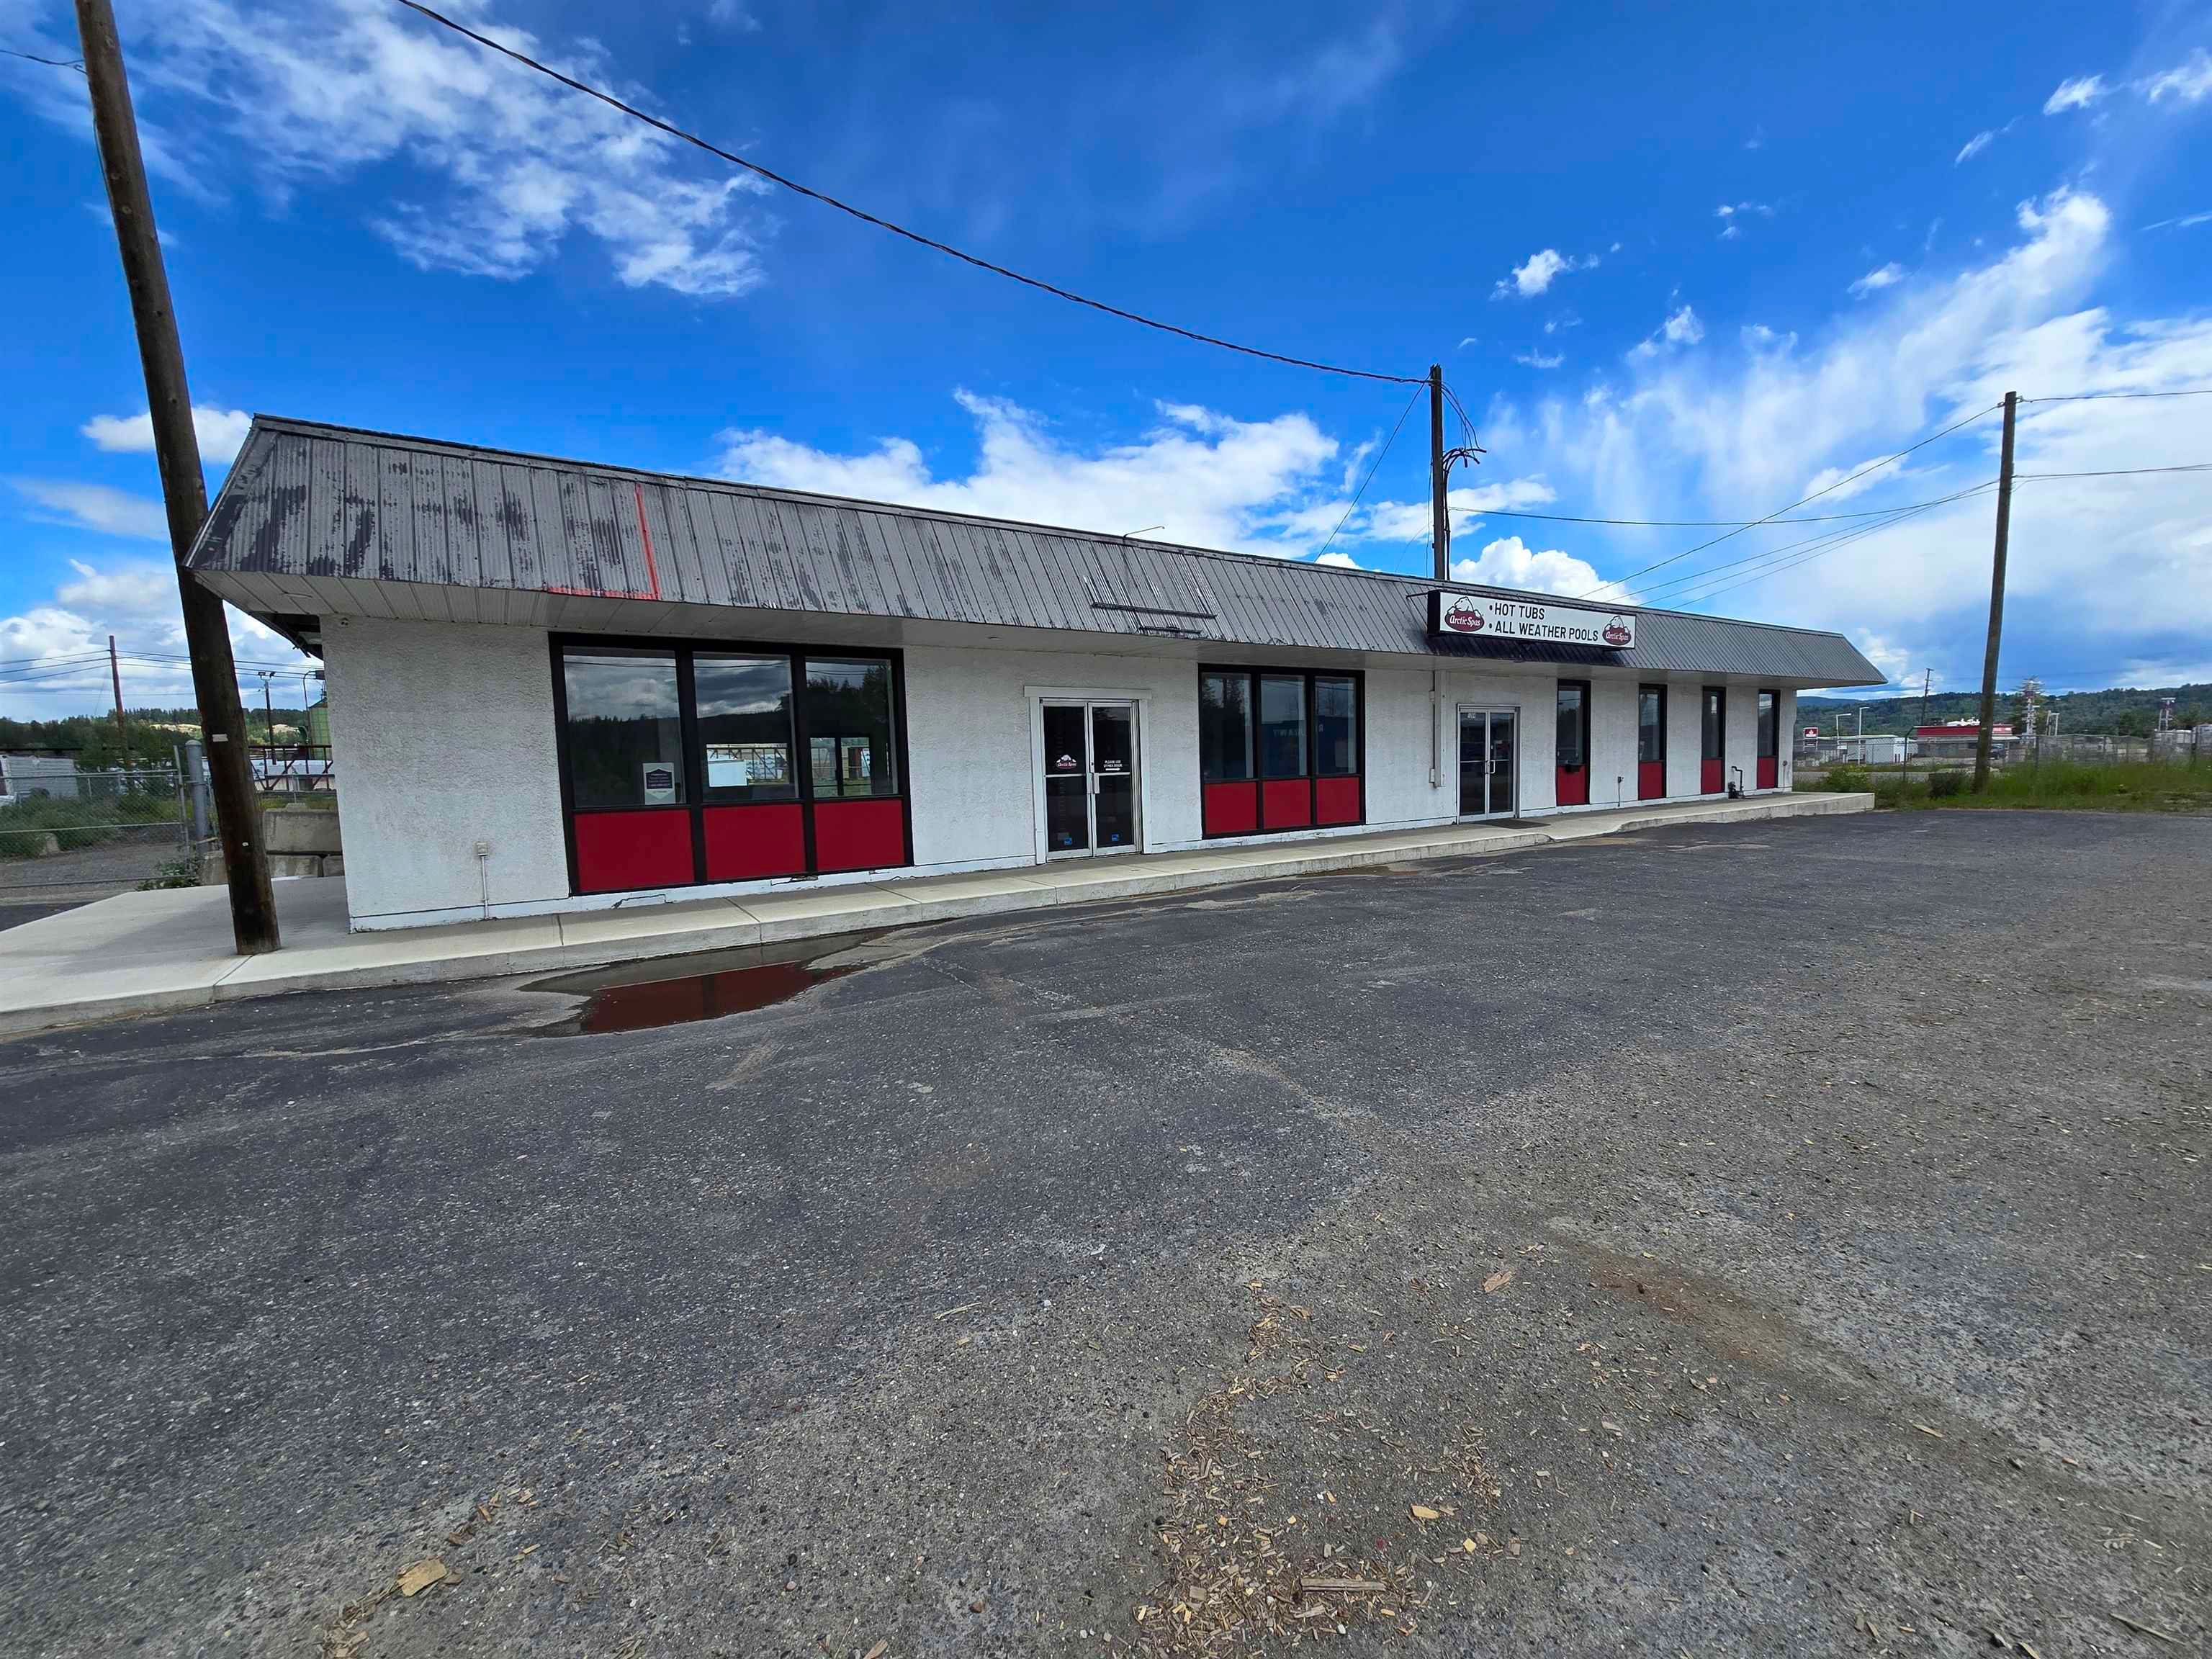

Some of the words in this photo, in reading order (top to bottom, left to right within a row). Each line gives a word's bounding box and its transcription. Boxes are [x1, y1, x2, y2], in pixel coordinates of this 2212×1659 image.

[1495, 603, 1516, 617] HOT
[1519, 606, 1545, 620] TUBS
[1467, 616, 1480, 627] Spas
[1495, 621, 1516, 634] ALL
[1519, 622, 1565, 639] WEATHER
[1569, 628, 1599, 642] POOLS
